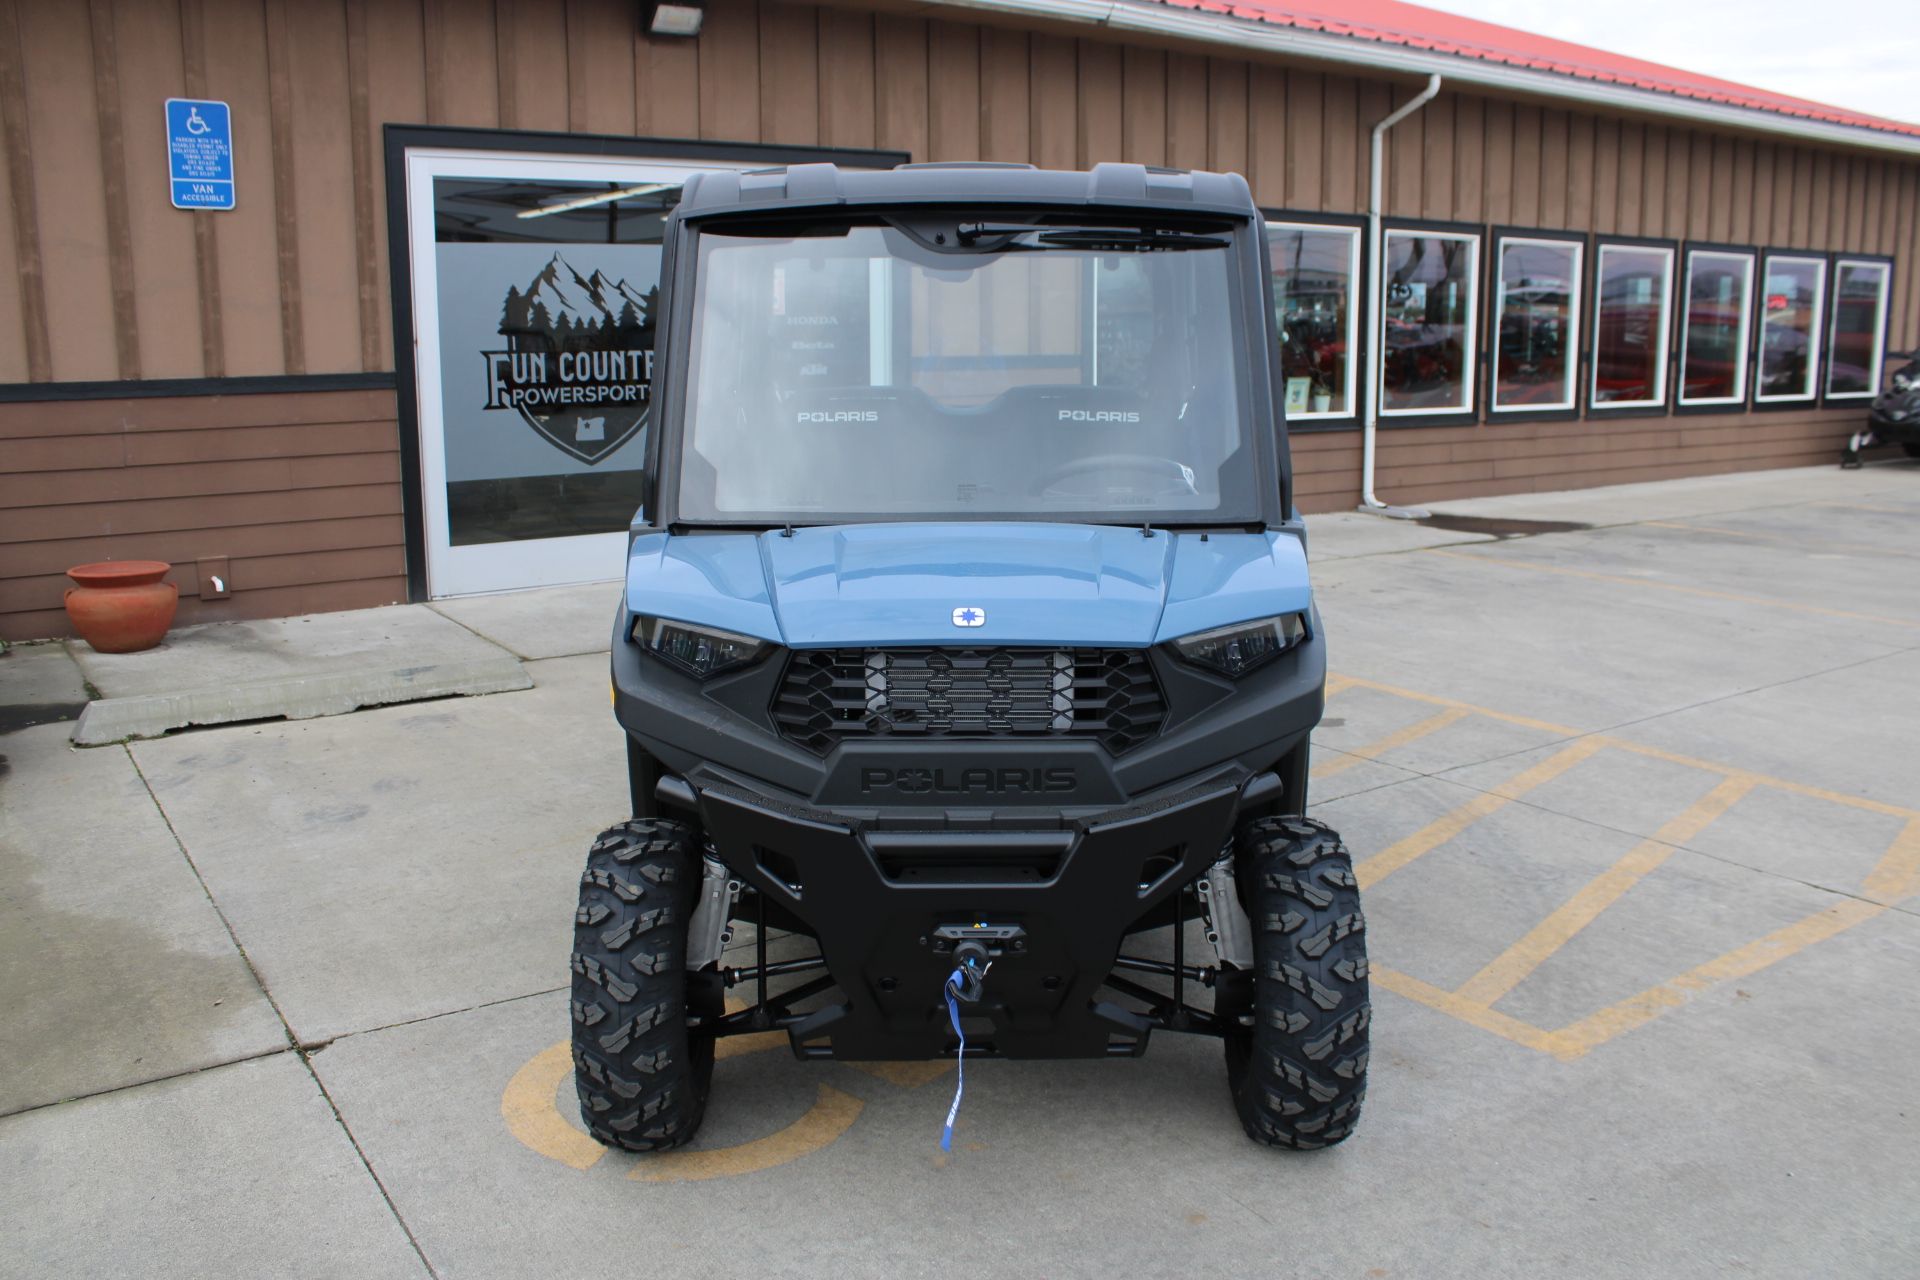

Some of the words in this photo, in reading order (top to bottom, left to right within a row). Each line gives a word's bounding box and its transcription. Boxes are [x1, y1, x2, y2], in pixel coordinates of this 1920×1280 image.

[192, 183, 214, 194] VAN
[182, 194, 225, 202] ACCESSIBLE
[787, 315, 839, 326] HONDA
[486, 350, 547, 409] FUN
[559, 350, 654, 382] COUNTR
[512, 384, 651, 405] POWERSPORT
[797, 411, 879, 423] POLARIS
[1058, 409, 1140, 423] POLARIS
[861, 767, 1078, 794] POLARIS
